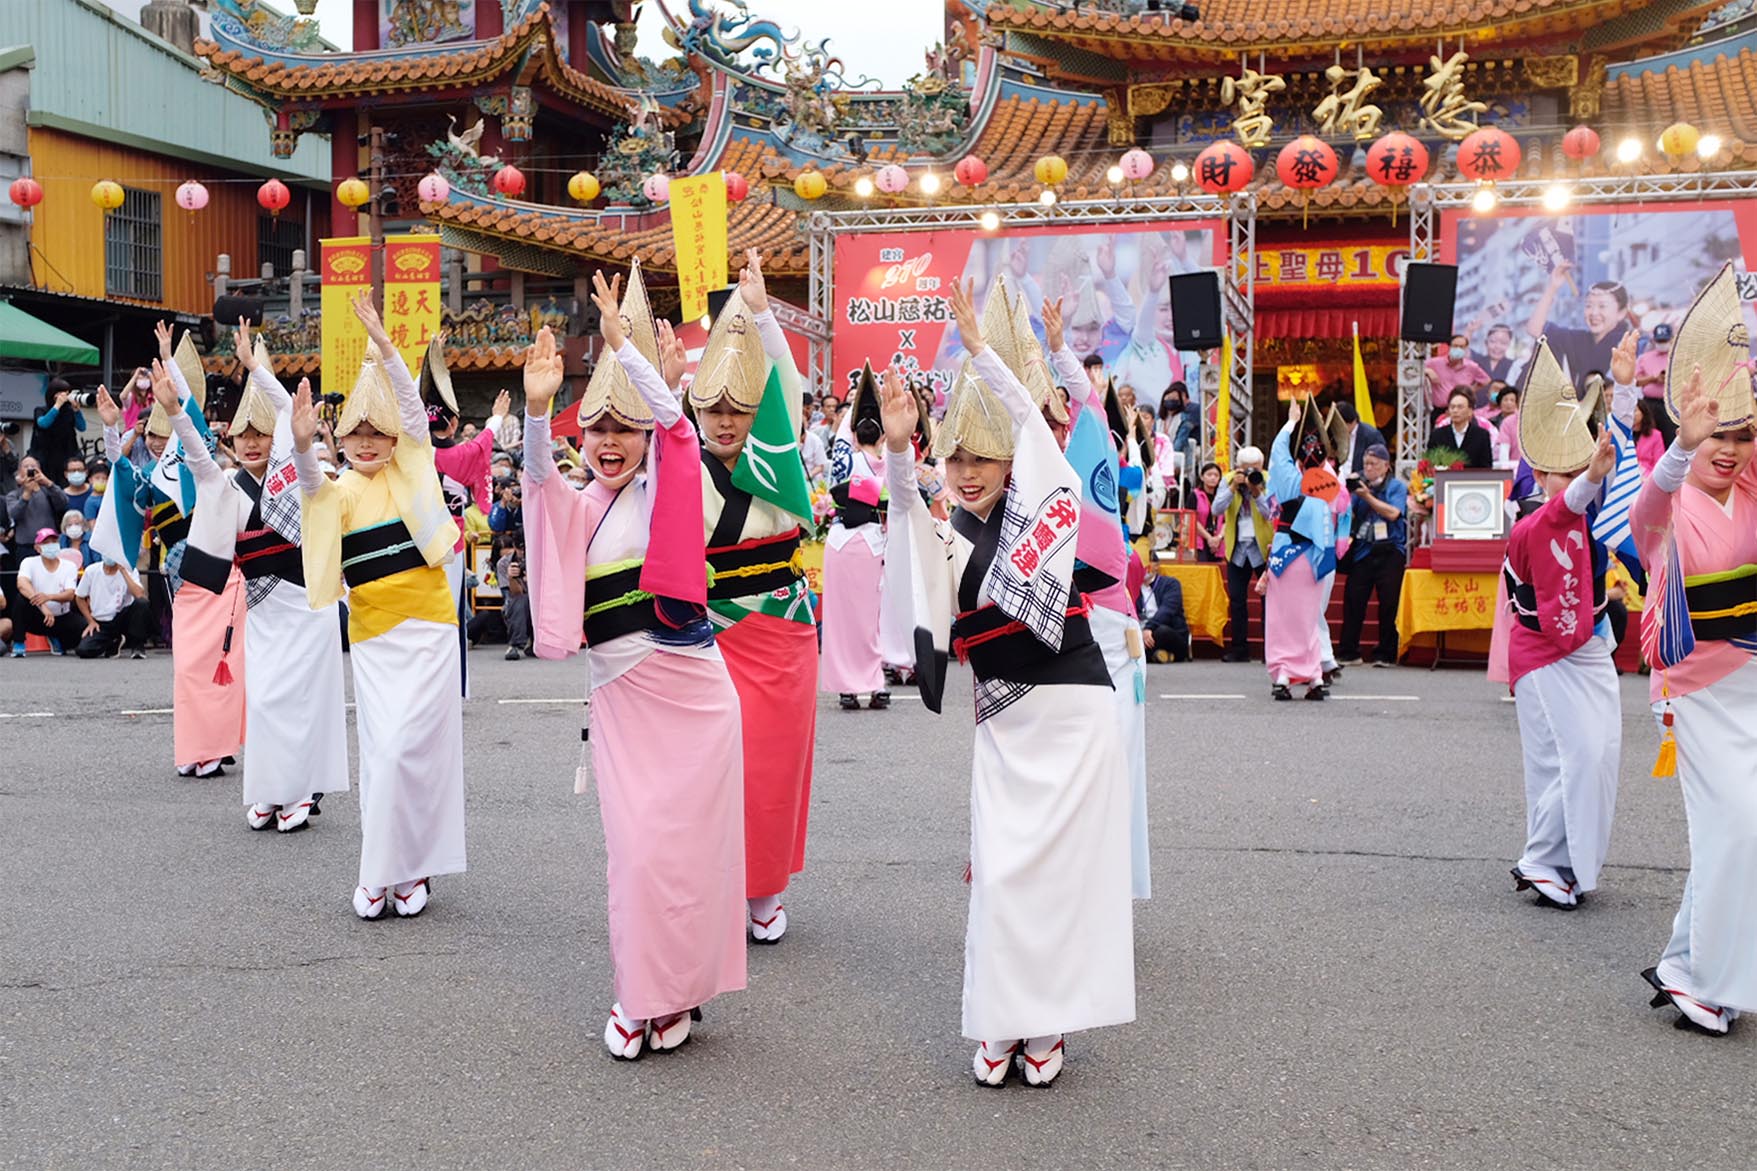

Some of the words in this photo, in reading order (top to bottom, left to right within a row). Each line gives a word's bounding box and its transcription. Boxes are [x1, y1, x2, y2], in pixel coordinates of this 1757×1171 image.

[1201, 153, 1237, 186] 財
[1291, 150, 1328, 183] 發
[1467, 140, 1503, 174] 恭
[848, 298, 957, 322] 松山慈祐
